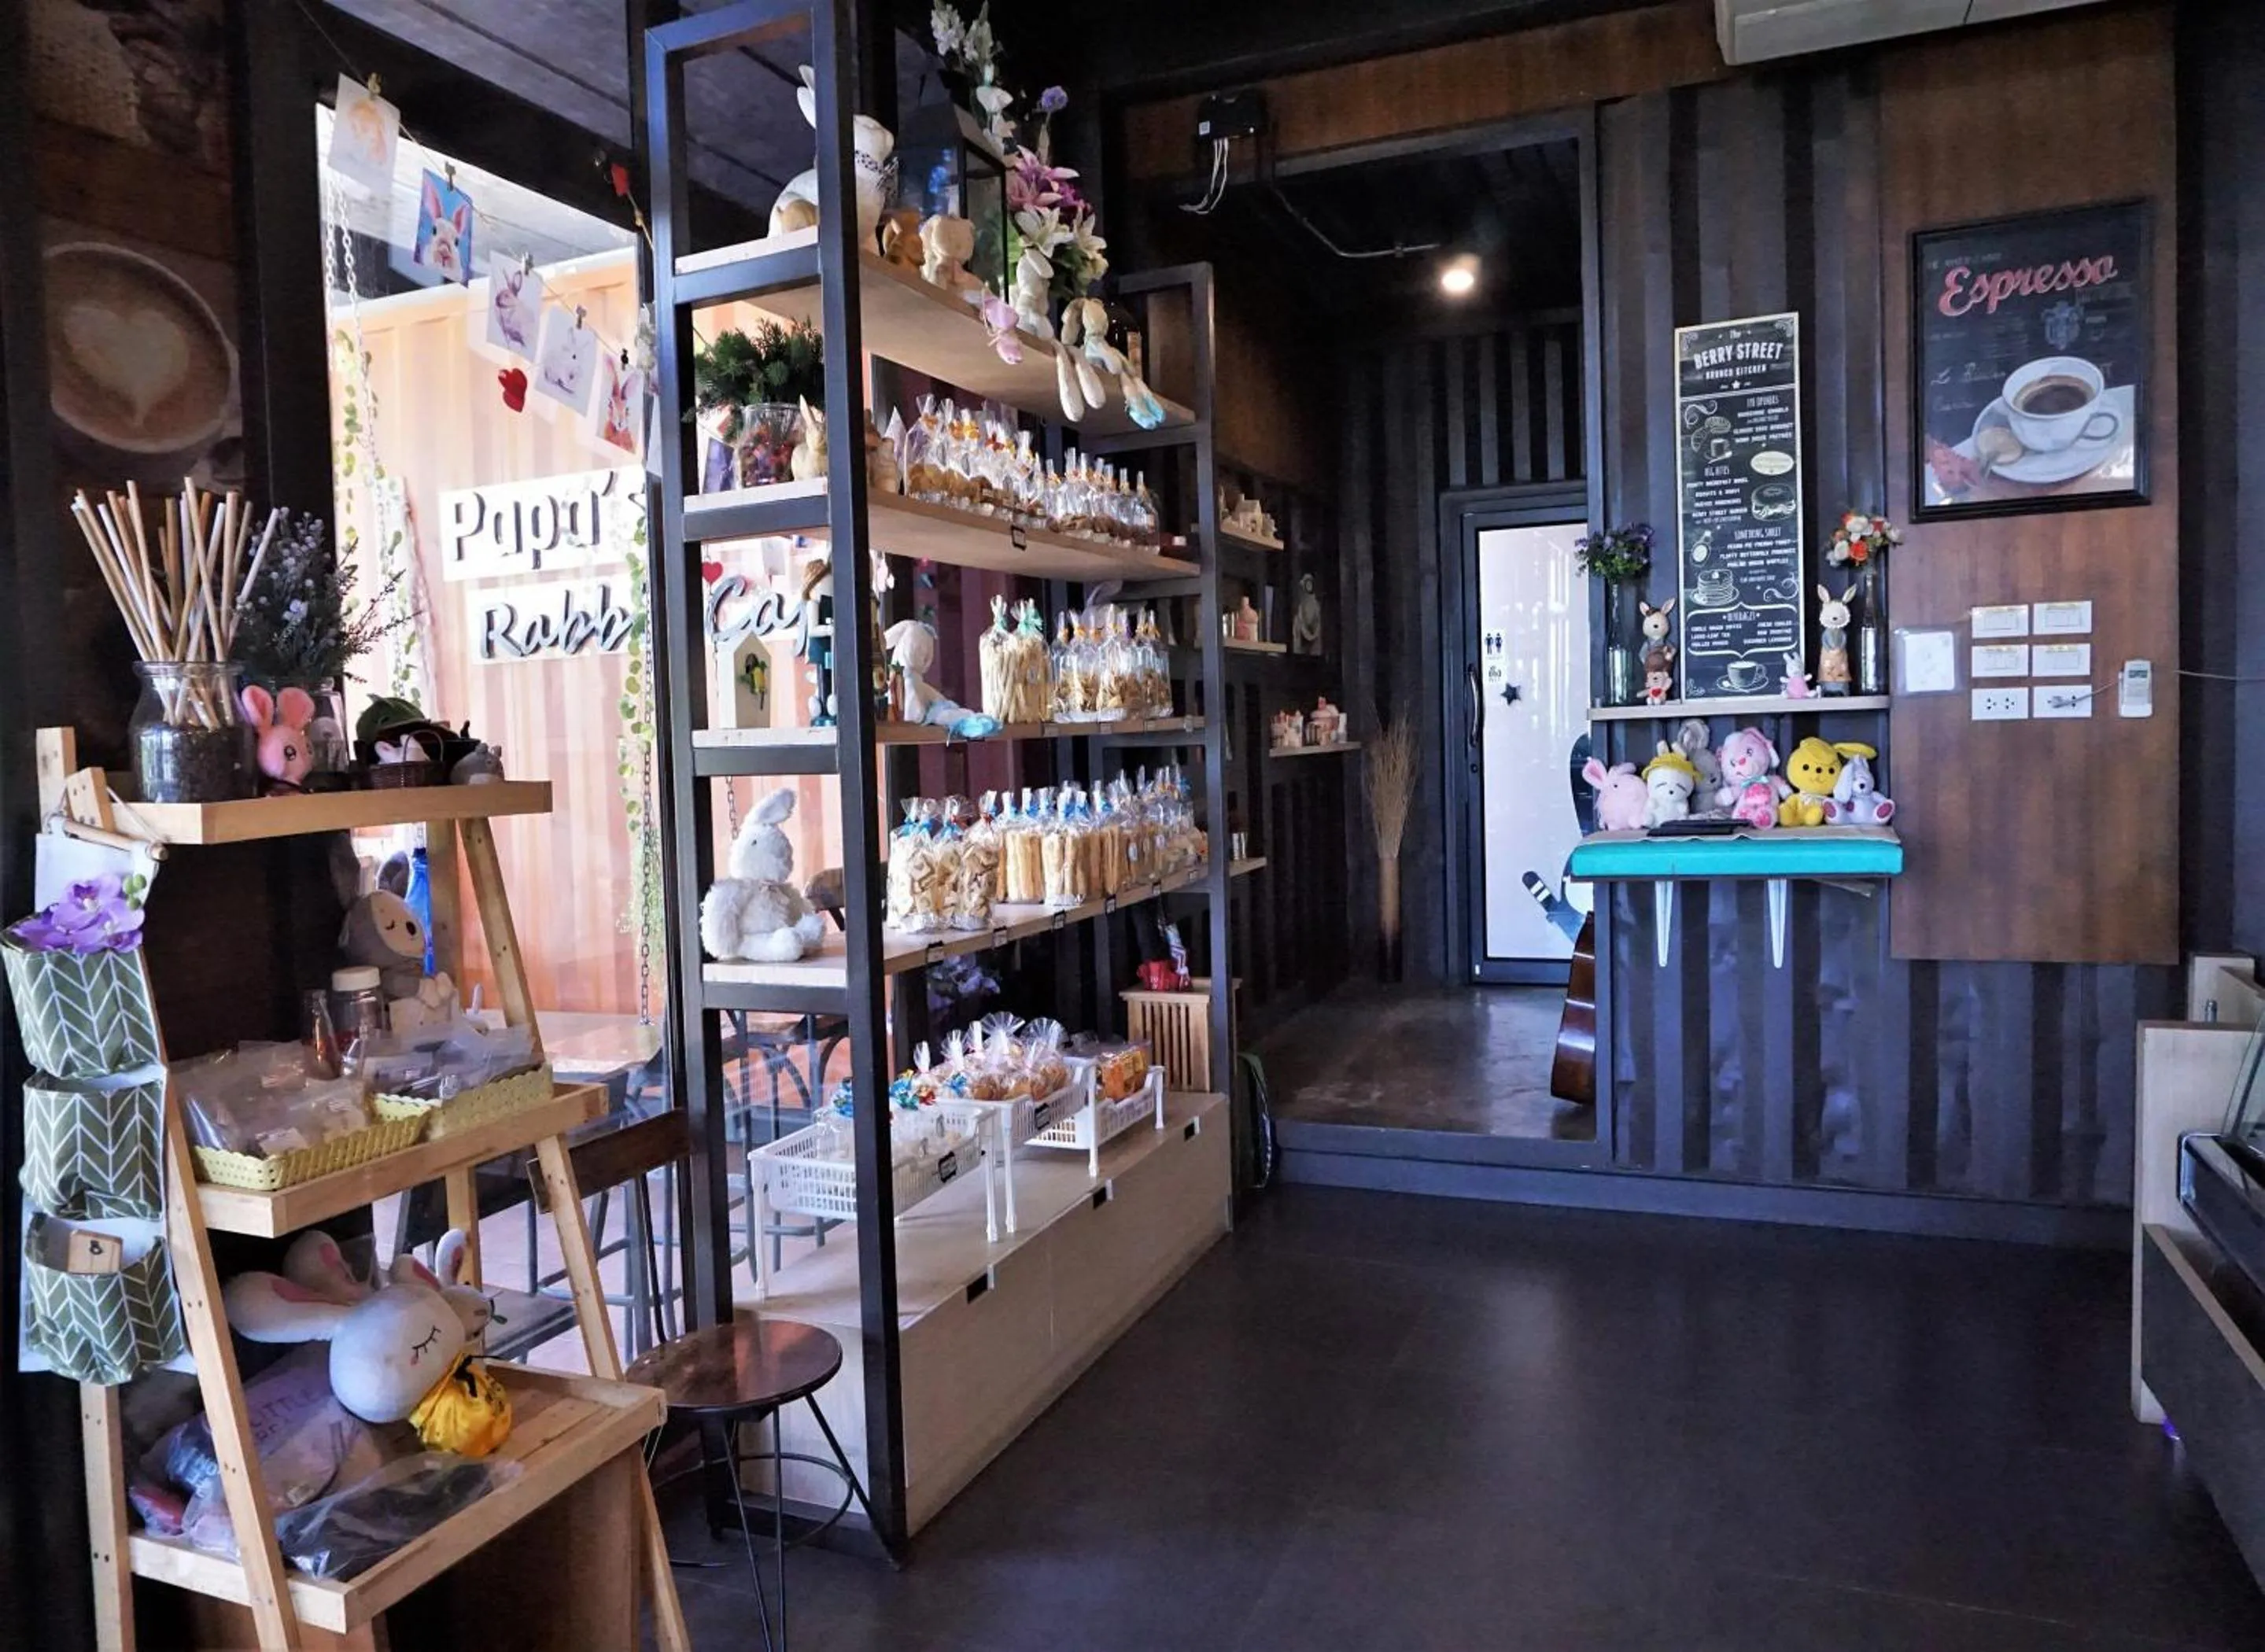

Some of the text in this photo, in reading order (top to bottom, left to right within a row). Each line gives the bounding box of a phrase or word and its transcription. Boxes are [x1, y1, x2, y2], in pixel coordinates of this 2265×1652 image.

[1939, 255, 2118, 317] Espresso
[1694, 342, 1784, 370] BERRY STREET
[481, 573, 808, 659] Rabb Caf
